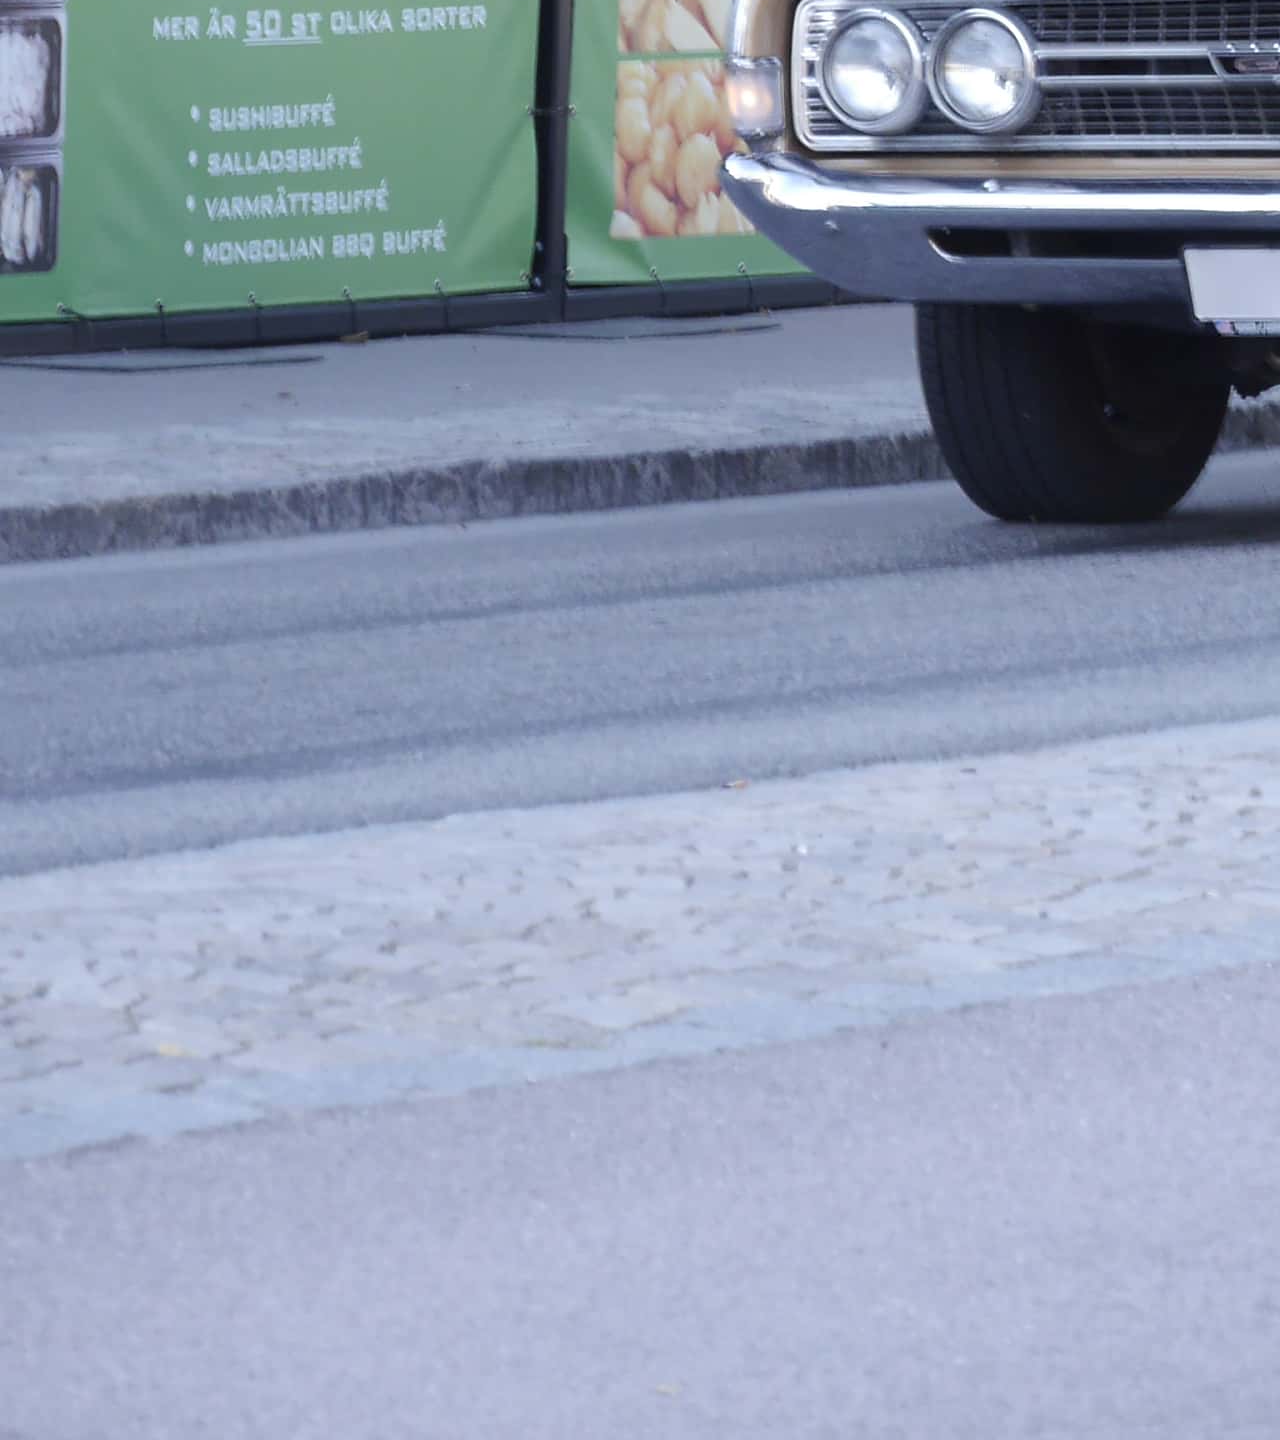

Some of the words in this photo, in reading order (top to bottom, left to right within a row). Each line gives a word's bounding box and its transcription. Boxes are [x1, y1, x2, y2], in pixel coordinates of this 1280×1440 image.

[152, 15, 199, 41] MER
[206, 7, 236, 40] ÄR
[291, 11, 322, 35] ST
[330, 9, 394, 35] OLIKA
[401, 5, 487, 32] SORTER
[209, 93, 336, 132] SUSHIBUFFÉ
[207, 136, 363, 177] SALLADSBUFFÉ
[204, 177, 389, 221] VARMRÄTTSBUFFÉ
[202, 236, 325, 266] MONGOLIAN
[332, 232, 375, 259] BBQ
[382, 218, 447, 256] BUFFÉ
